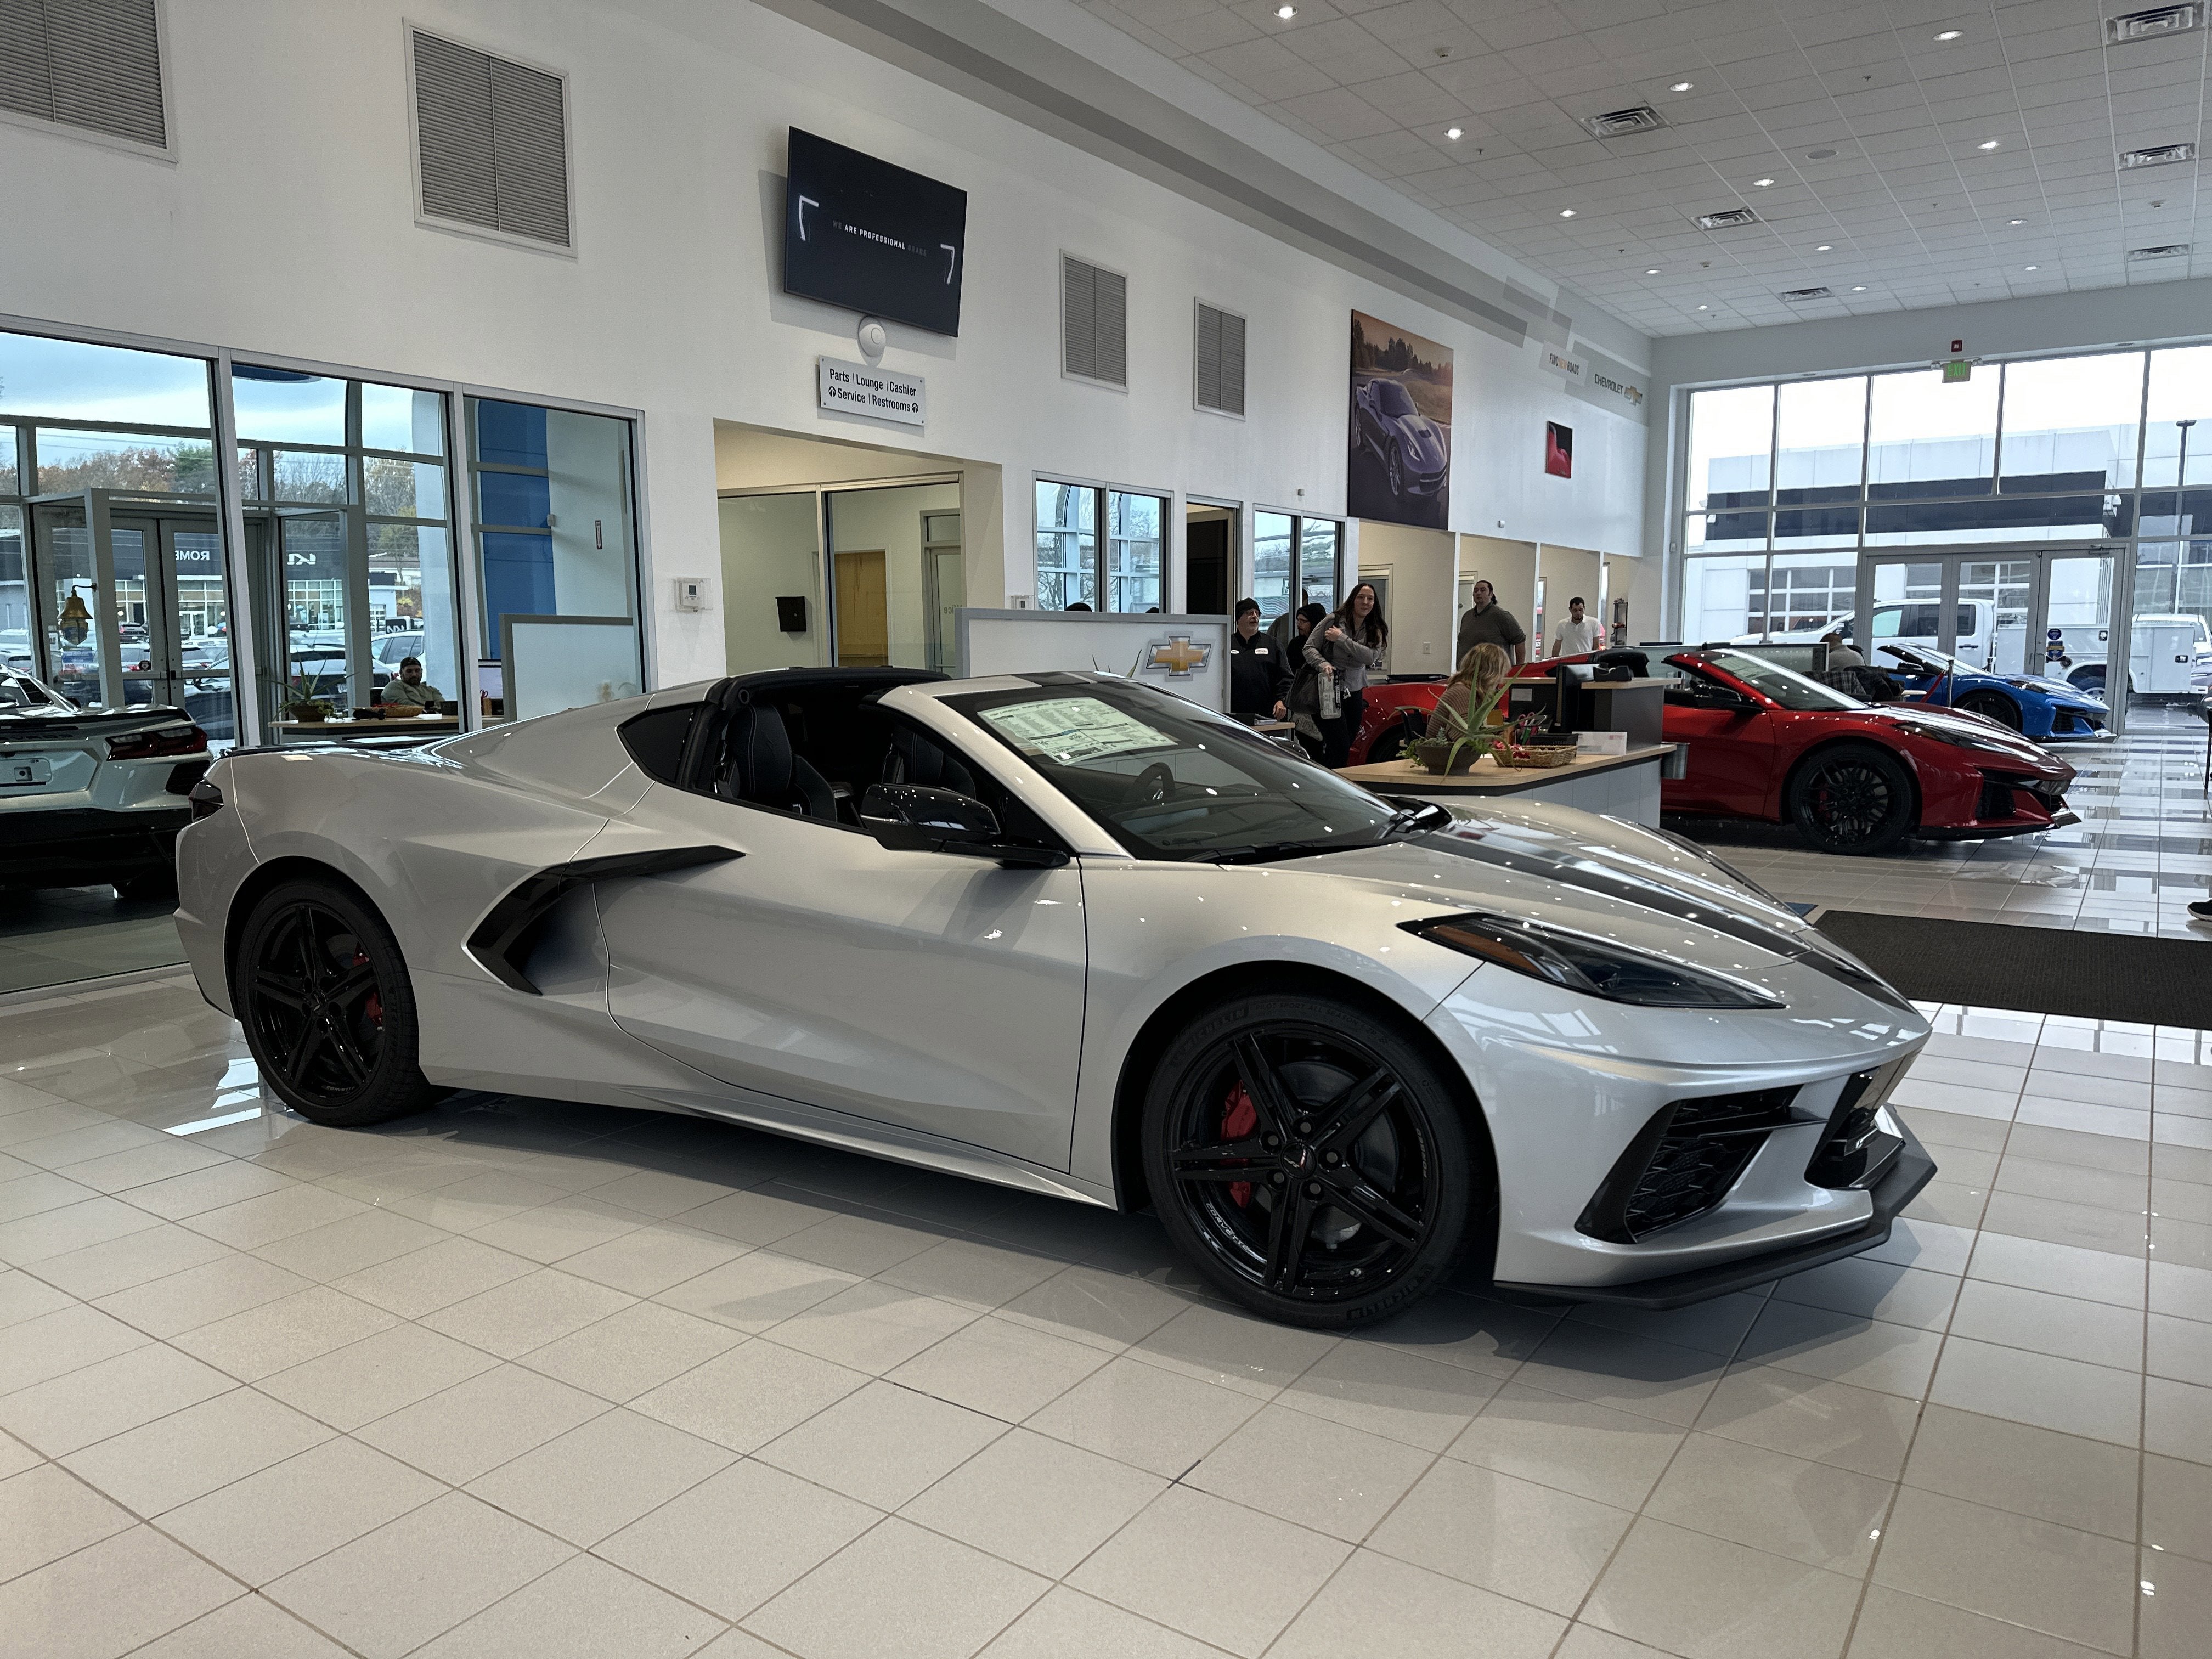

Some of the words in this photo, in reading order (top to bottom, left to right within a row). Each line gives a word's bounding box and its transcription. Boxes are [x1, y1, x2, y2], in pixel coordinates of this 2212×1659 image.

[844, 224, 857, 235] ARE
[859, 229, 905, 250] PROFESSIONAL
[1549, 353, 1559, 366] FIND
[1567, 361, 1579, 375] ROADS
[1948, 363, 1967, 377] EXIT
[830, 368, 850, 383] Parts
[856, 374, 883, 391] Lounge
[889, 381, 917, 397] Cashier
[1594, 374, 1623, 395] CHEVROLET
[837, 388, 866, 403] Service
[872, 395, 911, 412] Restrooms
[1183, 1008, 1246, 1053] MICHELIN
[1255, 1002, 1277, 1011] PILOT
[1307, 1005, 1323, 1013] ALL
[1325, 1008, 1358, 1026] SEASON
[1206, 1203, 1251, 1250] CORVETTE
